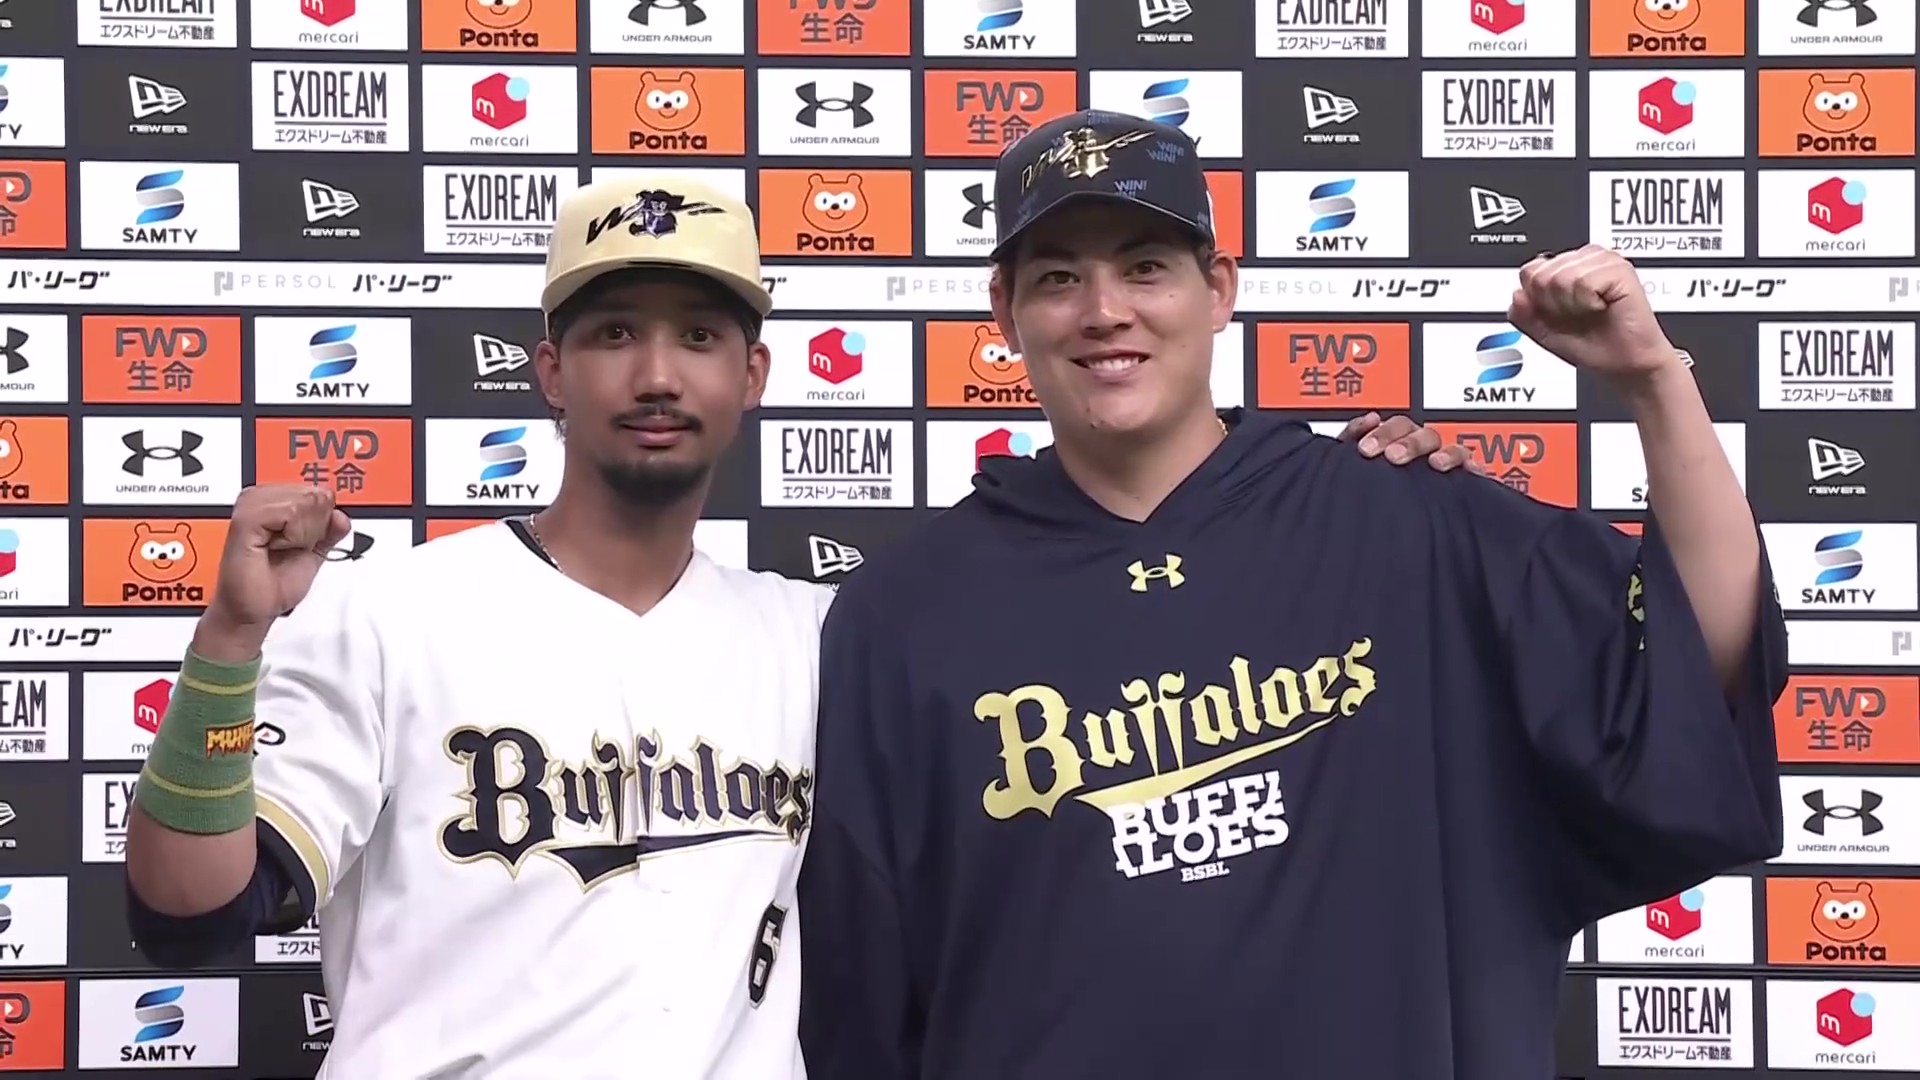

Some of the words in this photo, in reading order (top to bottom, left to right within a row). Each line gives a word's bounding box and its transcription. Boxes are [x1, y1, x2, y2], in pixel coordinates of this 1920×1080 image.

[101, 25, 214, 40] エクスドリーム不動産
[299, 32, 358, 43] mercari
[460, 28, 538, 47] Ponta
[801, 13, 864, 44] 生命
[964, 35, 1035, 49] SAMTY
[1278, 36, 1386, 50] エクスドリーム不動産
[1469, 39, 1527, 51] mercari
[1628, 33, 1706, 51] Ponta
[274, 70, 387, 118] EXDREAM
[957, 81, 1044, 112] FWD
[1444, 79, 1554, 125] EXDREAM
[275, 129, 386, 144] エクスドリーム不動産
[968, 114, 1031, 145] 生命
[470, 135, 528, 146] mercari
[629, 131, 707, 149] Ponta
[1444, 136, 1553, 150] エクスドリーム不動産
[1636, 139, 1695, 151] mercari
[1797, 133, 1876, 151] Ponta
[445, 174, 556, 221] EXDREAM
[1611, 178, 1722, 225] EXDREAM
[123, 228, 197, 243] SAMTY
[797, 233, 874, 251] Ponta
[1297, 236, 1367, 251] SAMTY
[1610, 237, 1722, 252] エクスドリーム不動産
[1806, 239, 1865, 250] mercari
[8, 271, 110, 289] パ・リーグ
[242, 275, 335, 288] PERSOL
[353, 274, 452, 292] パ・リーグ
[912, 280, 990, 294] PERSO
[1244, 280, 1336, 294] PERSOL
[1353, 280, 1449, 297] パ・リーグ
[1687, 279, 1786, 297] パ・リーグ
[116, 327, 207, 358] FWD
[1290, 334, 1377, 363] FWD
[1781, 330, 1893, 376] EXDREAM
[128, 360, 193, 392] 生命
[1300, 366, 1363, 397] 生命
[297, 383, 369, 397] SAMTY
[807, 389, 864, 400] mercari
[1464, 387, 1535, 402] SAMTY
[1782, 388, 1893, 402] エクスドリーム不動産
[289, 429, 378, 459] FWD
[782, 428, 892, 474] EXDREAM
[300, 462, 365, 493] 生命
[1487, 467, 1530, 493] 命
[467, 484, 539, 498] SAMTY
[783, 486, 891, 499] エクスドリーム不動産
[123, 583, 203, 601] Ponta
[1802, 589, 1875, 603] SAMTY
[9, 628, 112, 647] パ・リーグ
[1796, 687, 1886, 717] FWD
[974, 635, 1377, 820] Buffaloes
[1808, 720, 1872, 751] 生命
[436, 722, 814, 884] Buffaloes
[1180, 860, 1231, 882] BSBL
[748, 899, 790, 1010] 6
[1645, 945, 1704, 957] mercari
[1806, 942, 1886, 961] Ponta
[1619, 986, 1731, 1034] EXDREAM
[121, 1045, 196, 1061] SAMTY
[1620, 1045, 1731, 1060] エクスドリーム不動産
[1816, 1051, 1875, 1063] mercari
